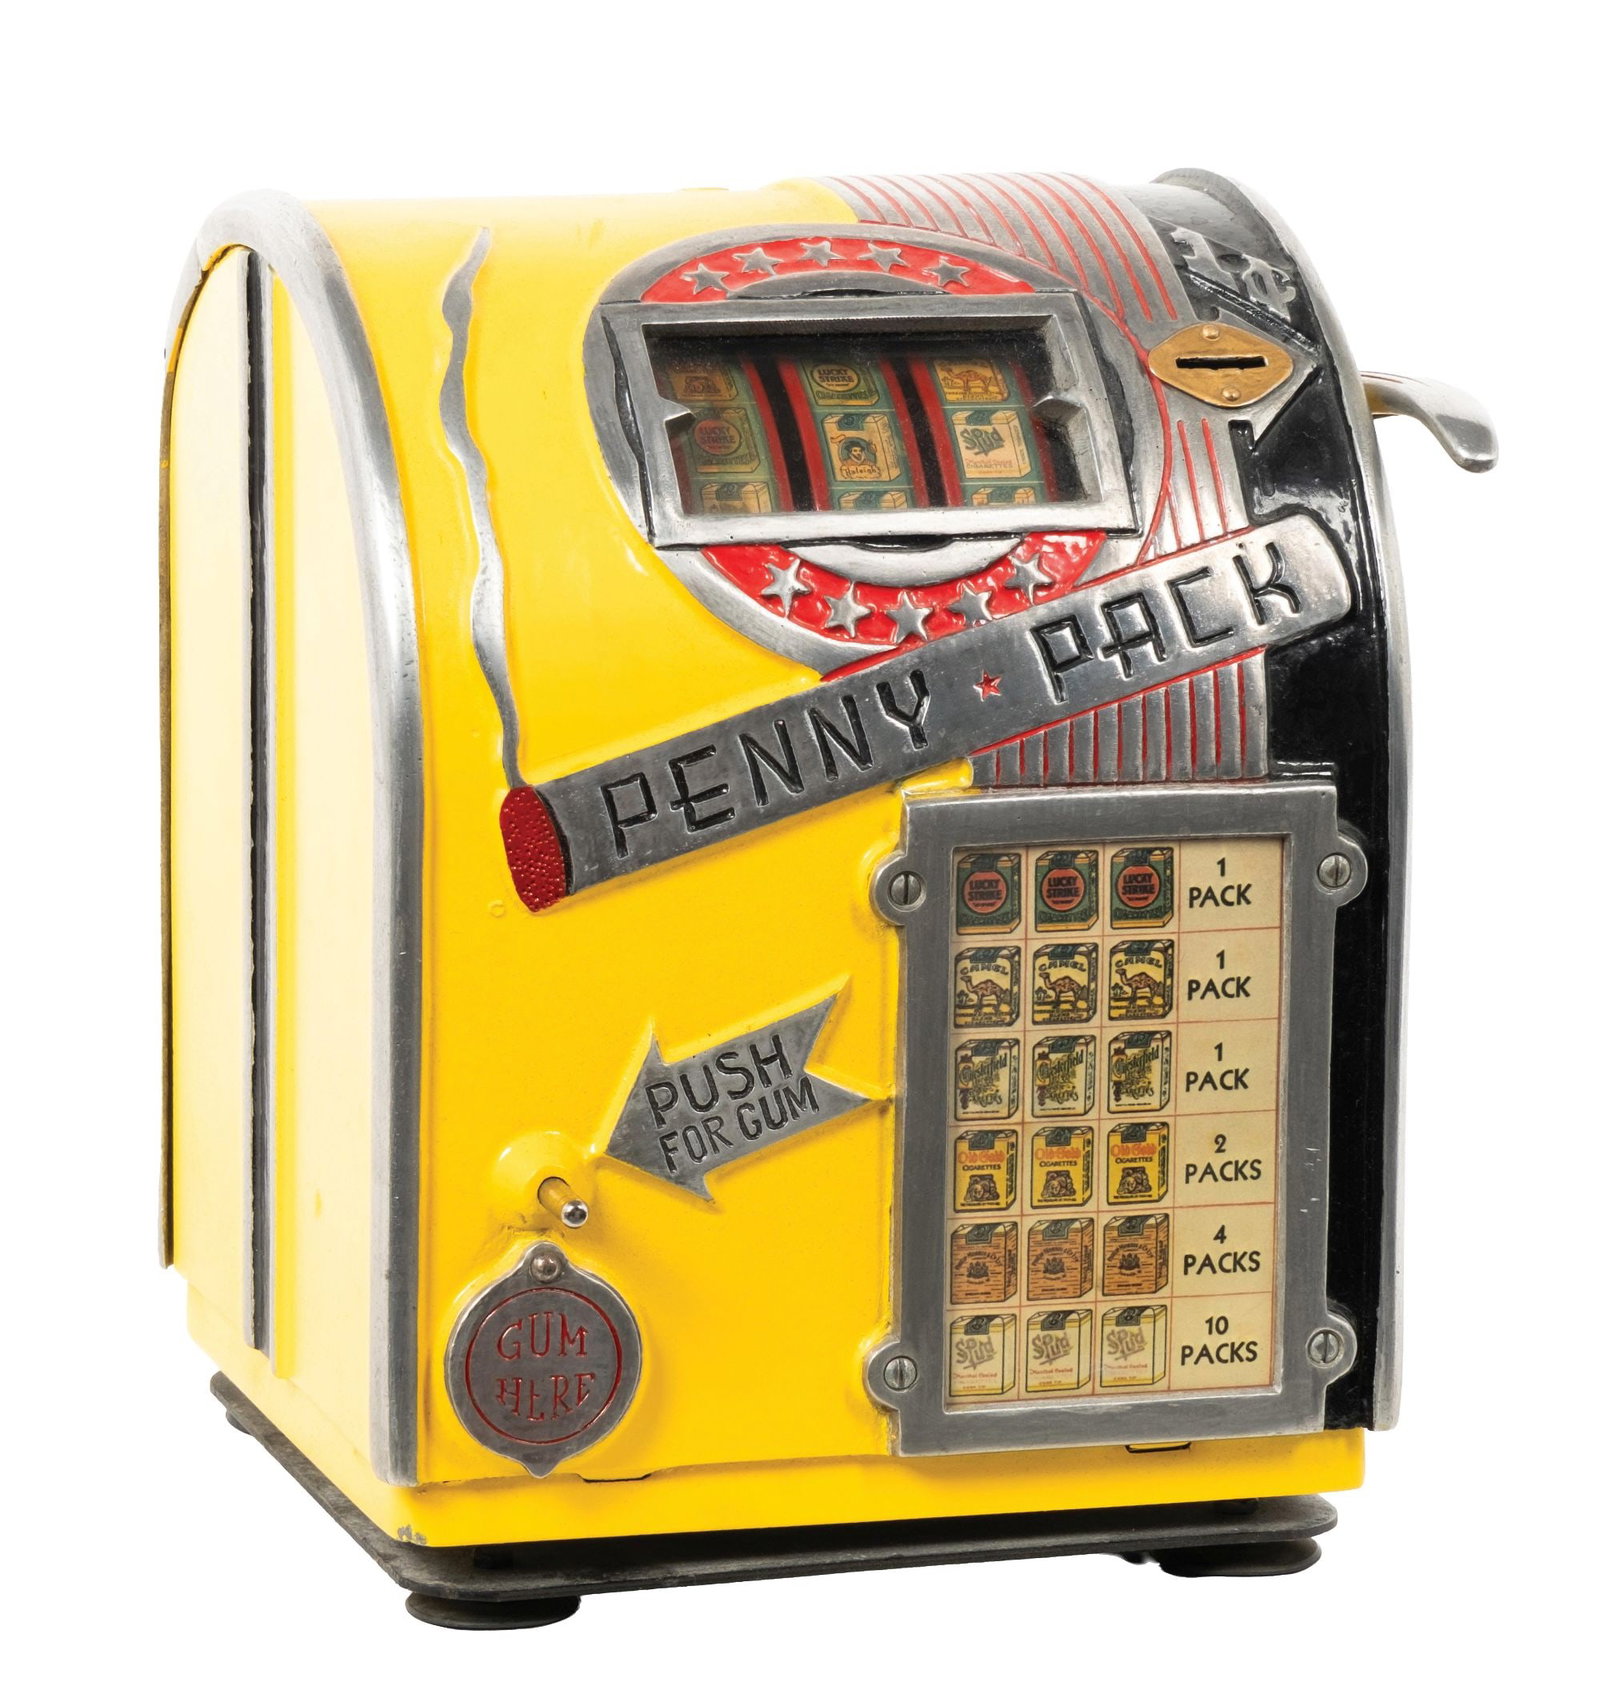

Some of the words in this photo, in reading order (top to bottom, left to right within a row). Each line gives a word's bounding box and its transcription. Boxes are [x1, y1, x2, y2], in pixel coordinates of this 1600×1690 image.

[818, 368, 849, 376] LUCKY
[818, 375, 855, 383] STRIKE
[600, 670, 932, 858] PENNY
[1031, 541, 1302, 703] PACK
[1216, 857, 1226, 877] 1
[969, 878, 1001, 889] LUCKY
[1047, 876, 1078, 888] LUCKY
[1123, 873, 1154, 884] LUCKY
[968, 890, 1002, 902] STRIKE
[1046, 887, 1080, 899] STRIKE
[1122, 884, 1155, 896] STRIKE
[1189, 883, 1252, 909] PACK
[1038, 959, 1087, 972] CAMEL
[1114, 954, 1163, 969] CAMEL
[1215, 949, 1226, 970] 1
[960, 963, 1009, 976] CAMEL
[1187, 976, 1251, 1001] PACK
[1214, 1043, 1224, 1062] 1
[645, 1034, 793, 1129] PUSH
[1185, 1068, 1250, 1093] PACK
[659, 1115, 734, 1175] FOR
[737, 1075, 820, 1141] GUM
[1214, 1134, 1227, 1153] 2
[962, 1163, 1001, 1171] CIGARETTES
[1039, 1160, 1077, 1168] CIGARETTES
[1115, 1156, 1153, 1164] CIGARETTES
[1184, 1159, 1262, 1184] PACKS
[1213, 1225, 1227, 1244] 4
[1183, 1251, 1261, 1276] PACKS
[1205, 1316, 1229, 1335] 10
[496, 1311, 588, 1361] GUM
[1181, 1341, 1258, 1366] PACKS
[496, 1372, 596, 1422] HERE
